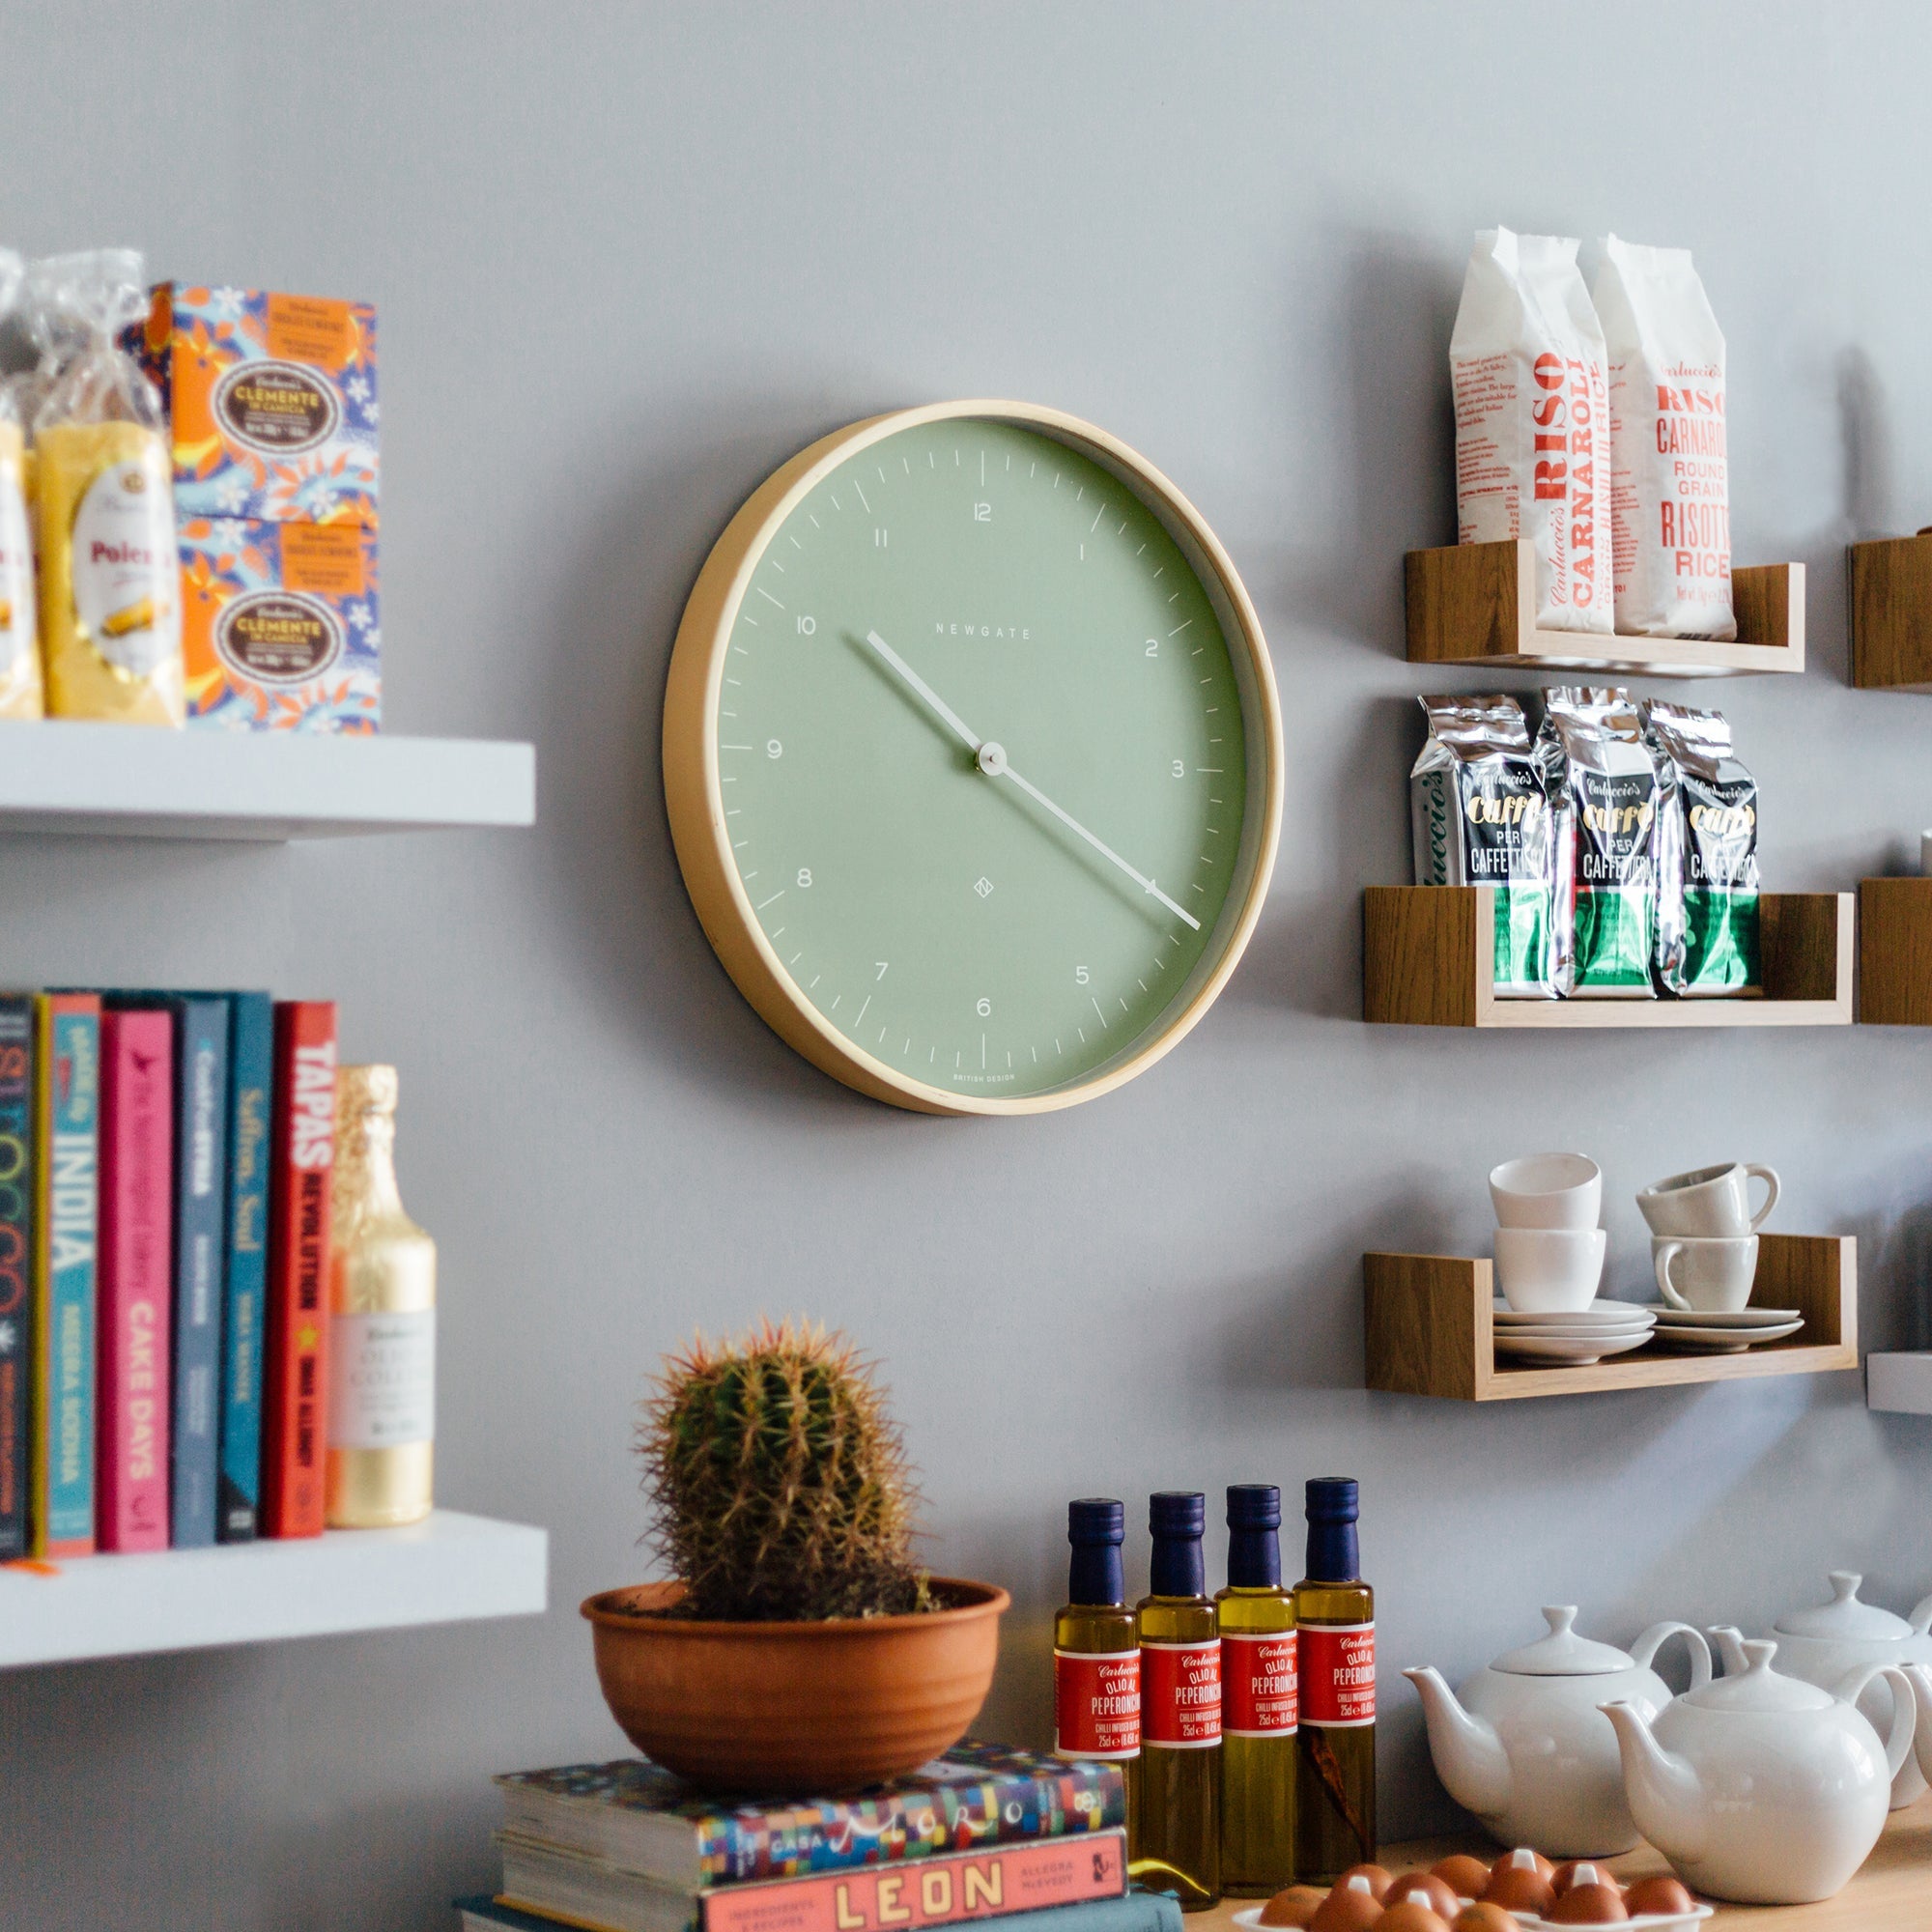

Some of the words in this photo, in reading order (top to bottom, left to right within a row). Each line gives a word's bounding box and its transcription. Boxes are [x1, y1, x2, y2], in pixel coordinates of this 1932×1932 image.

[235, 385, 319, 408] CLEMENTE
[1533, 352, 1568, 502] RISO
[1674, 461, 1724, 480] ROUND
[1566, 357, 1595, 609] CARNAROLI
[1679, 480, 1724, 498] GRAIN
[974, 502, 992, 522] 12
[875, 528, 888, 548] 11
[1079, 544, 1085, 561] 1
[1549, 506, 1567, 608] Carluccio's
[1675, 551, 1730, 579] RICE
[237, 617, 321, 638] CLEMENTE
[796, 616, 816, 636] 10
[935, 622, 1030, 639] NEWGATE
[1145, 639, 1158, 658] 2
[766, 739, 782, 758] 9
[1172, 759, 1185, 779] 3
[1496, 831, 1521, 845] PER
[1609, 838, 1634, 852] PER
[797, 867, 813, 888] 8
[874, 961, 889, 981] 7
[1075, 965, 1090, 985] 5
[976, 998, 991, 1017] 6
[952, 1072, 984, 1084] BRITISH
[986, 1072, 1015, 1084] DESIGN
[293, 1040, 334, 1170] TAPAS
[52, 1133, 96, 1272] INDIA
[299, 1172, 324, 1310] REVOLUTION
[129, 1300, 156, 1390] CAKE
[128, 1398, 156, 1480] DAYS
[1347, 1649, 1366, 1665] OLIO
[1189, 1668, 1209, 1685] OLIO
[1264, 1659, 1286, 1675] OLIO
[1105, 1678, 1127, 1695] OLIO
[1337, 1692, 1352, 1703] CHILLI
[1256, 1702, 1271, 1713] CHILLI
[1340, 1704, 1352, 1717] 25cl
[1179, 1713, 1195, 1723] CHILLI
[1259, 1714, 1271, 1726] 25cl
[1095, 1723, 1111, 1734] CHILLI
[1182, 1724, 1195, 1737] 25cl
[1098, 1736, 1111, 1747] 25cl
[772, 1833, 822, 1853] CASA
[835, 1861, 1004, 1930] LEON
